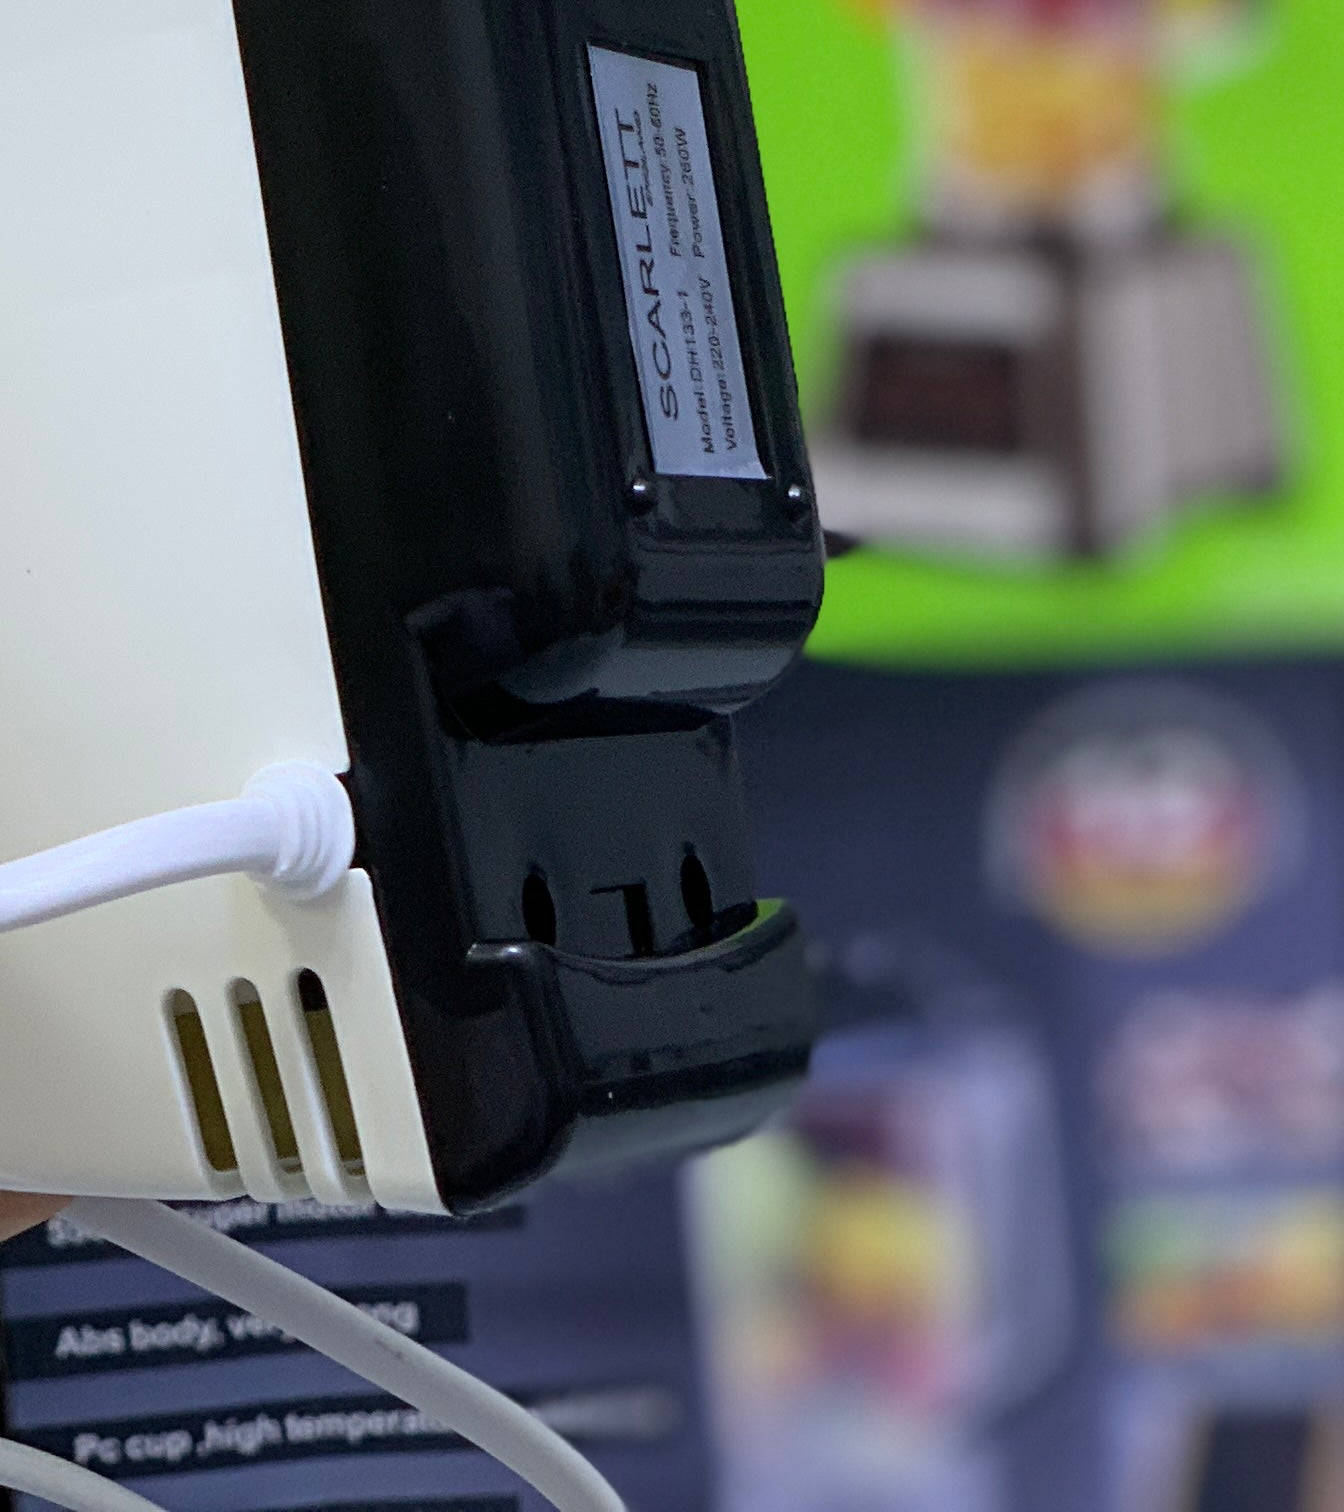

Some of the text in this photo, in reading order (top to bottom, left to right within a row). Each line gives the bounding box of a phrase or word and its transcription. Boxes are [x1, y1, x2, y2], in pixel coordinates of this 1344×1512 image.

[614, 105, 680, 422] SCARLETT
[55, 1324, 125, 1358] Abs
[123, 1429, 194, 1464] cup
